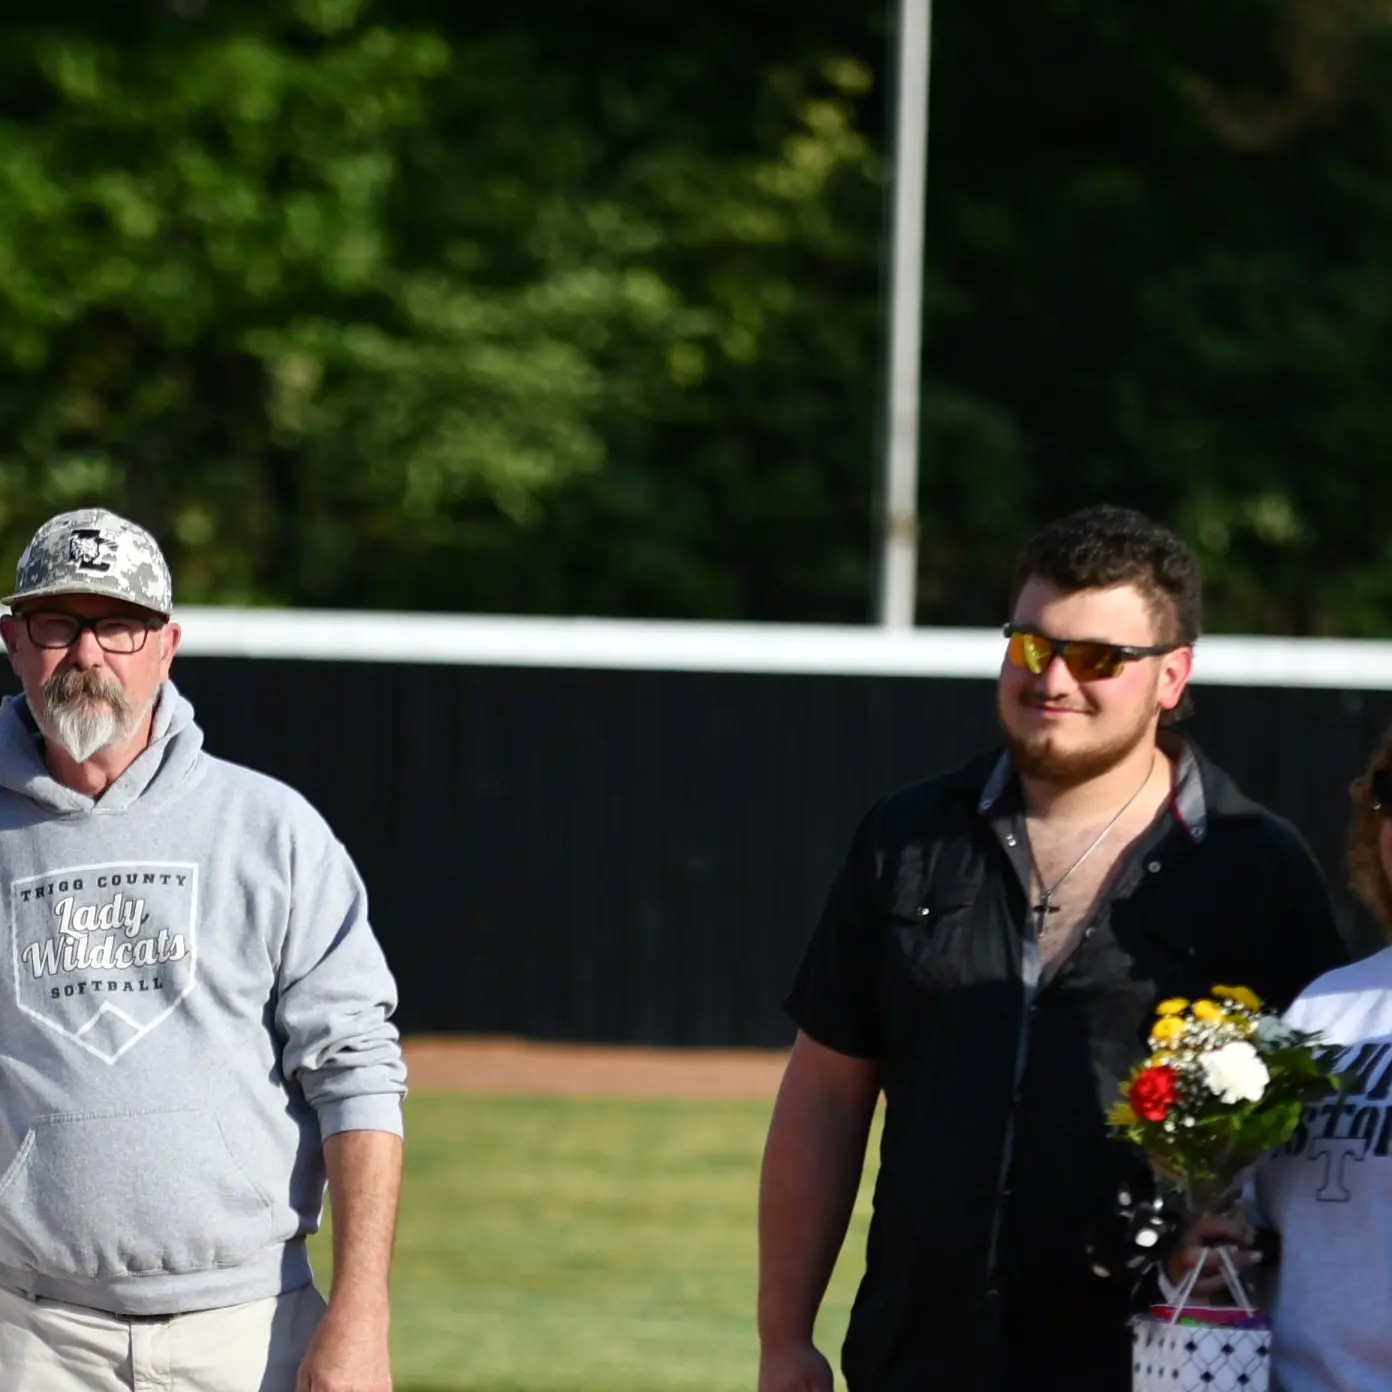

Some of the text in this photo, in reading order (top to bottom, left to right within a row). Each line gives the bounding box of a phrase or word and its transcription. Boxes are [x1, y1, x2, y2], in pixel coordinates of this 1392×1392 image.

[20, 873, 188, 902] TRIGG COUNTY
[54, 892, 150, 939] Lady
[21, 928, 191, 979] Wildcats
[51, 977, 165, 999] SOFTBALL
